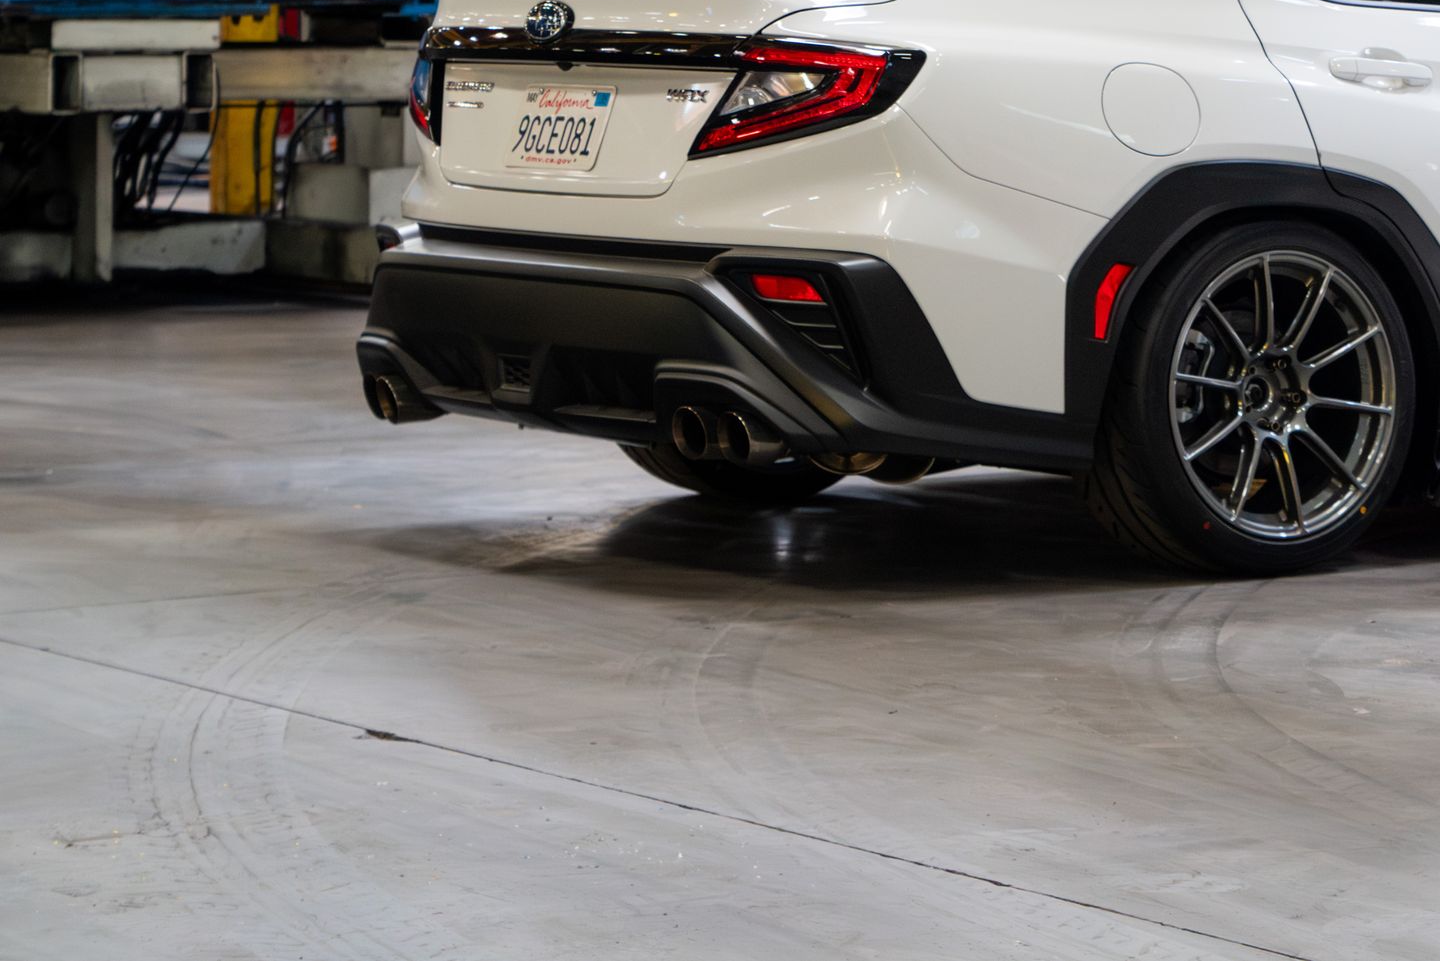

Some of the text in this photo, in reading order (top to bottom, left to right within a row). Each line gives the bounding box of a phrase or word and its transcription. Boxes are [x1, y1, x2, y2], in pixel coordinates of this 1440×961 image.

[538, 87, 594, 115] California
[511, 114, 596, 156] 9GCE081
[525, 155, 572, 165] dmv.ca.gov
